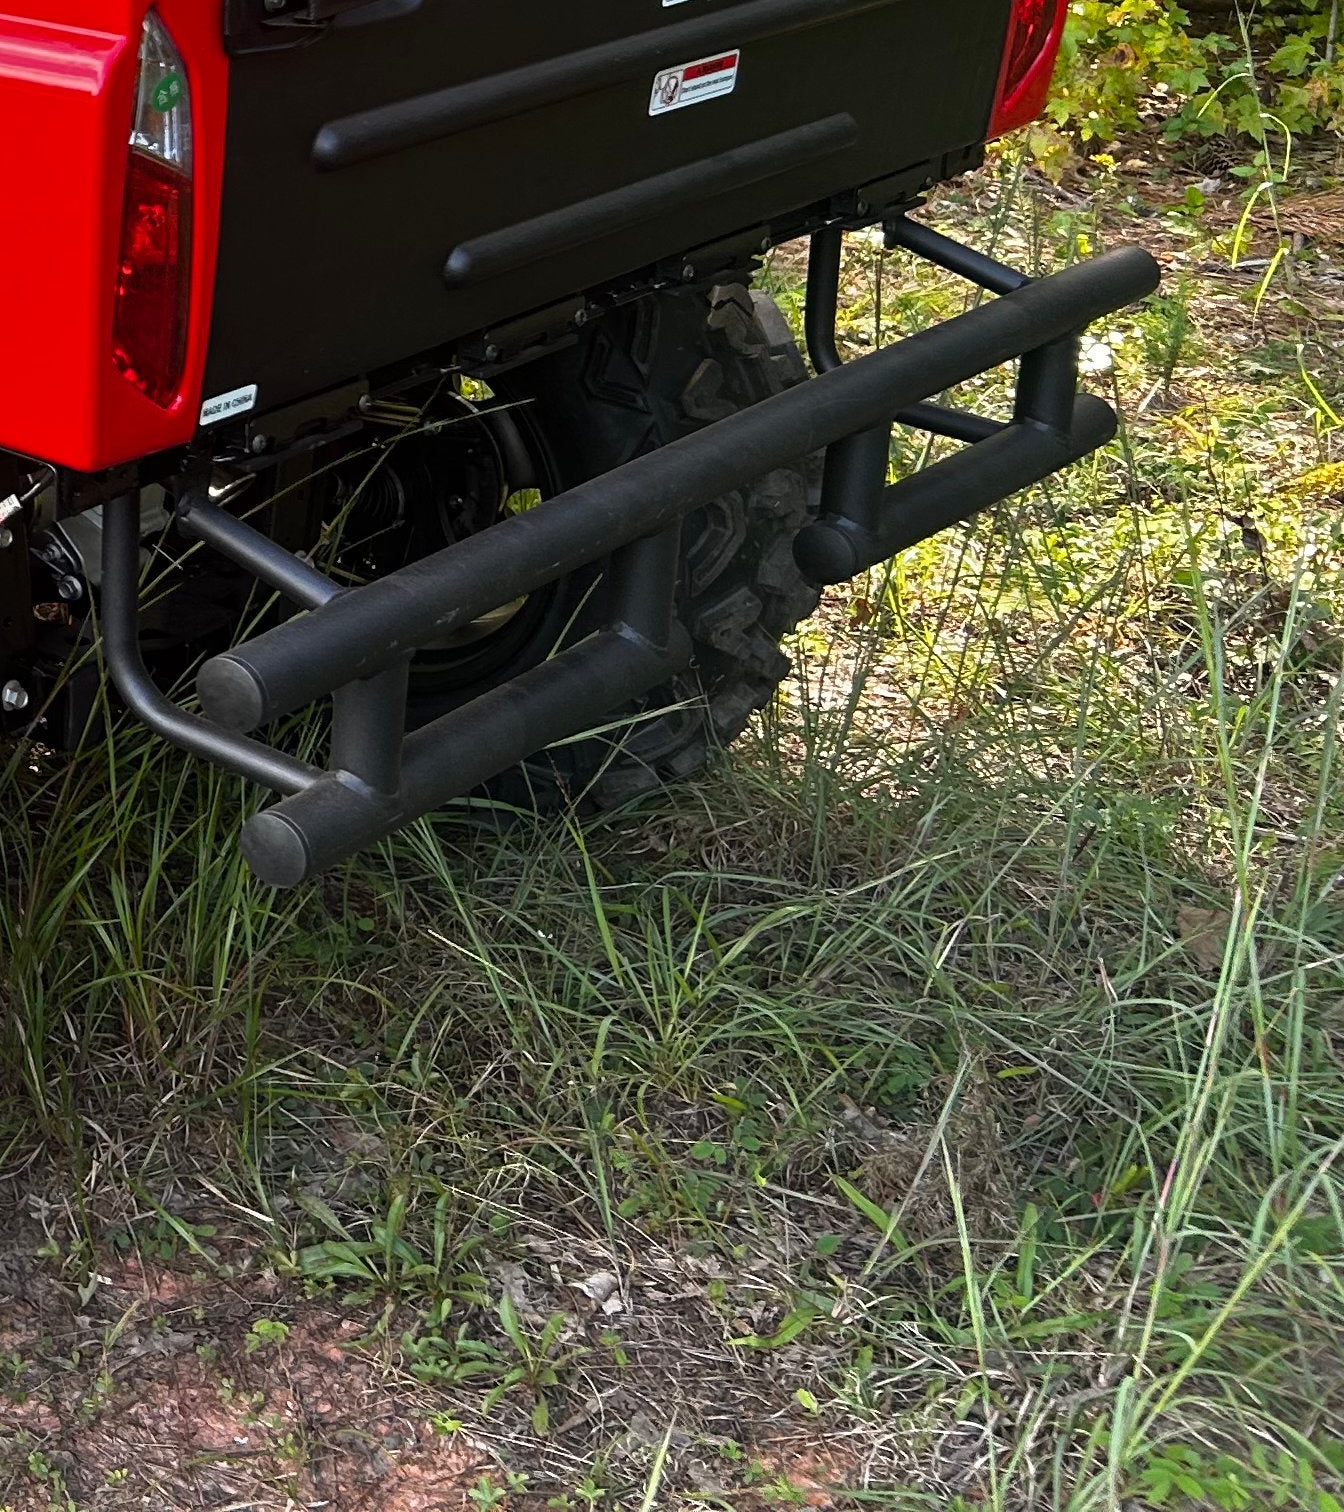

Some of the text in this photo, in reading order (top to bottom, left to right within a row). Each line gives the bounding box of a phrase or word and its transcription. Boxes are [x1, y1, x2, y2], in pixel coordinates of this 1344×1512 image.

[203, 394, 252, 416] MADE IN CHINA
